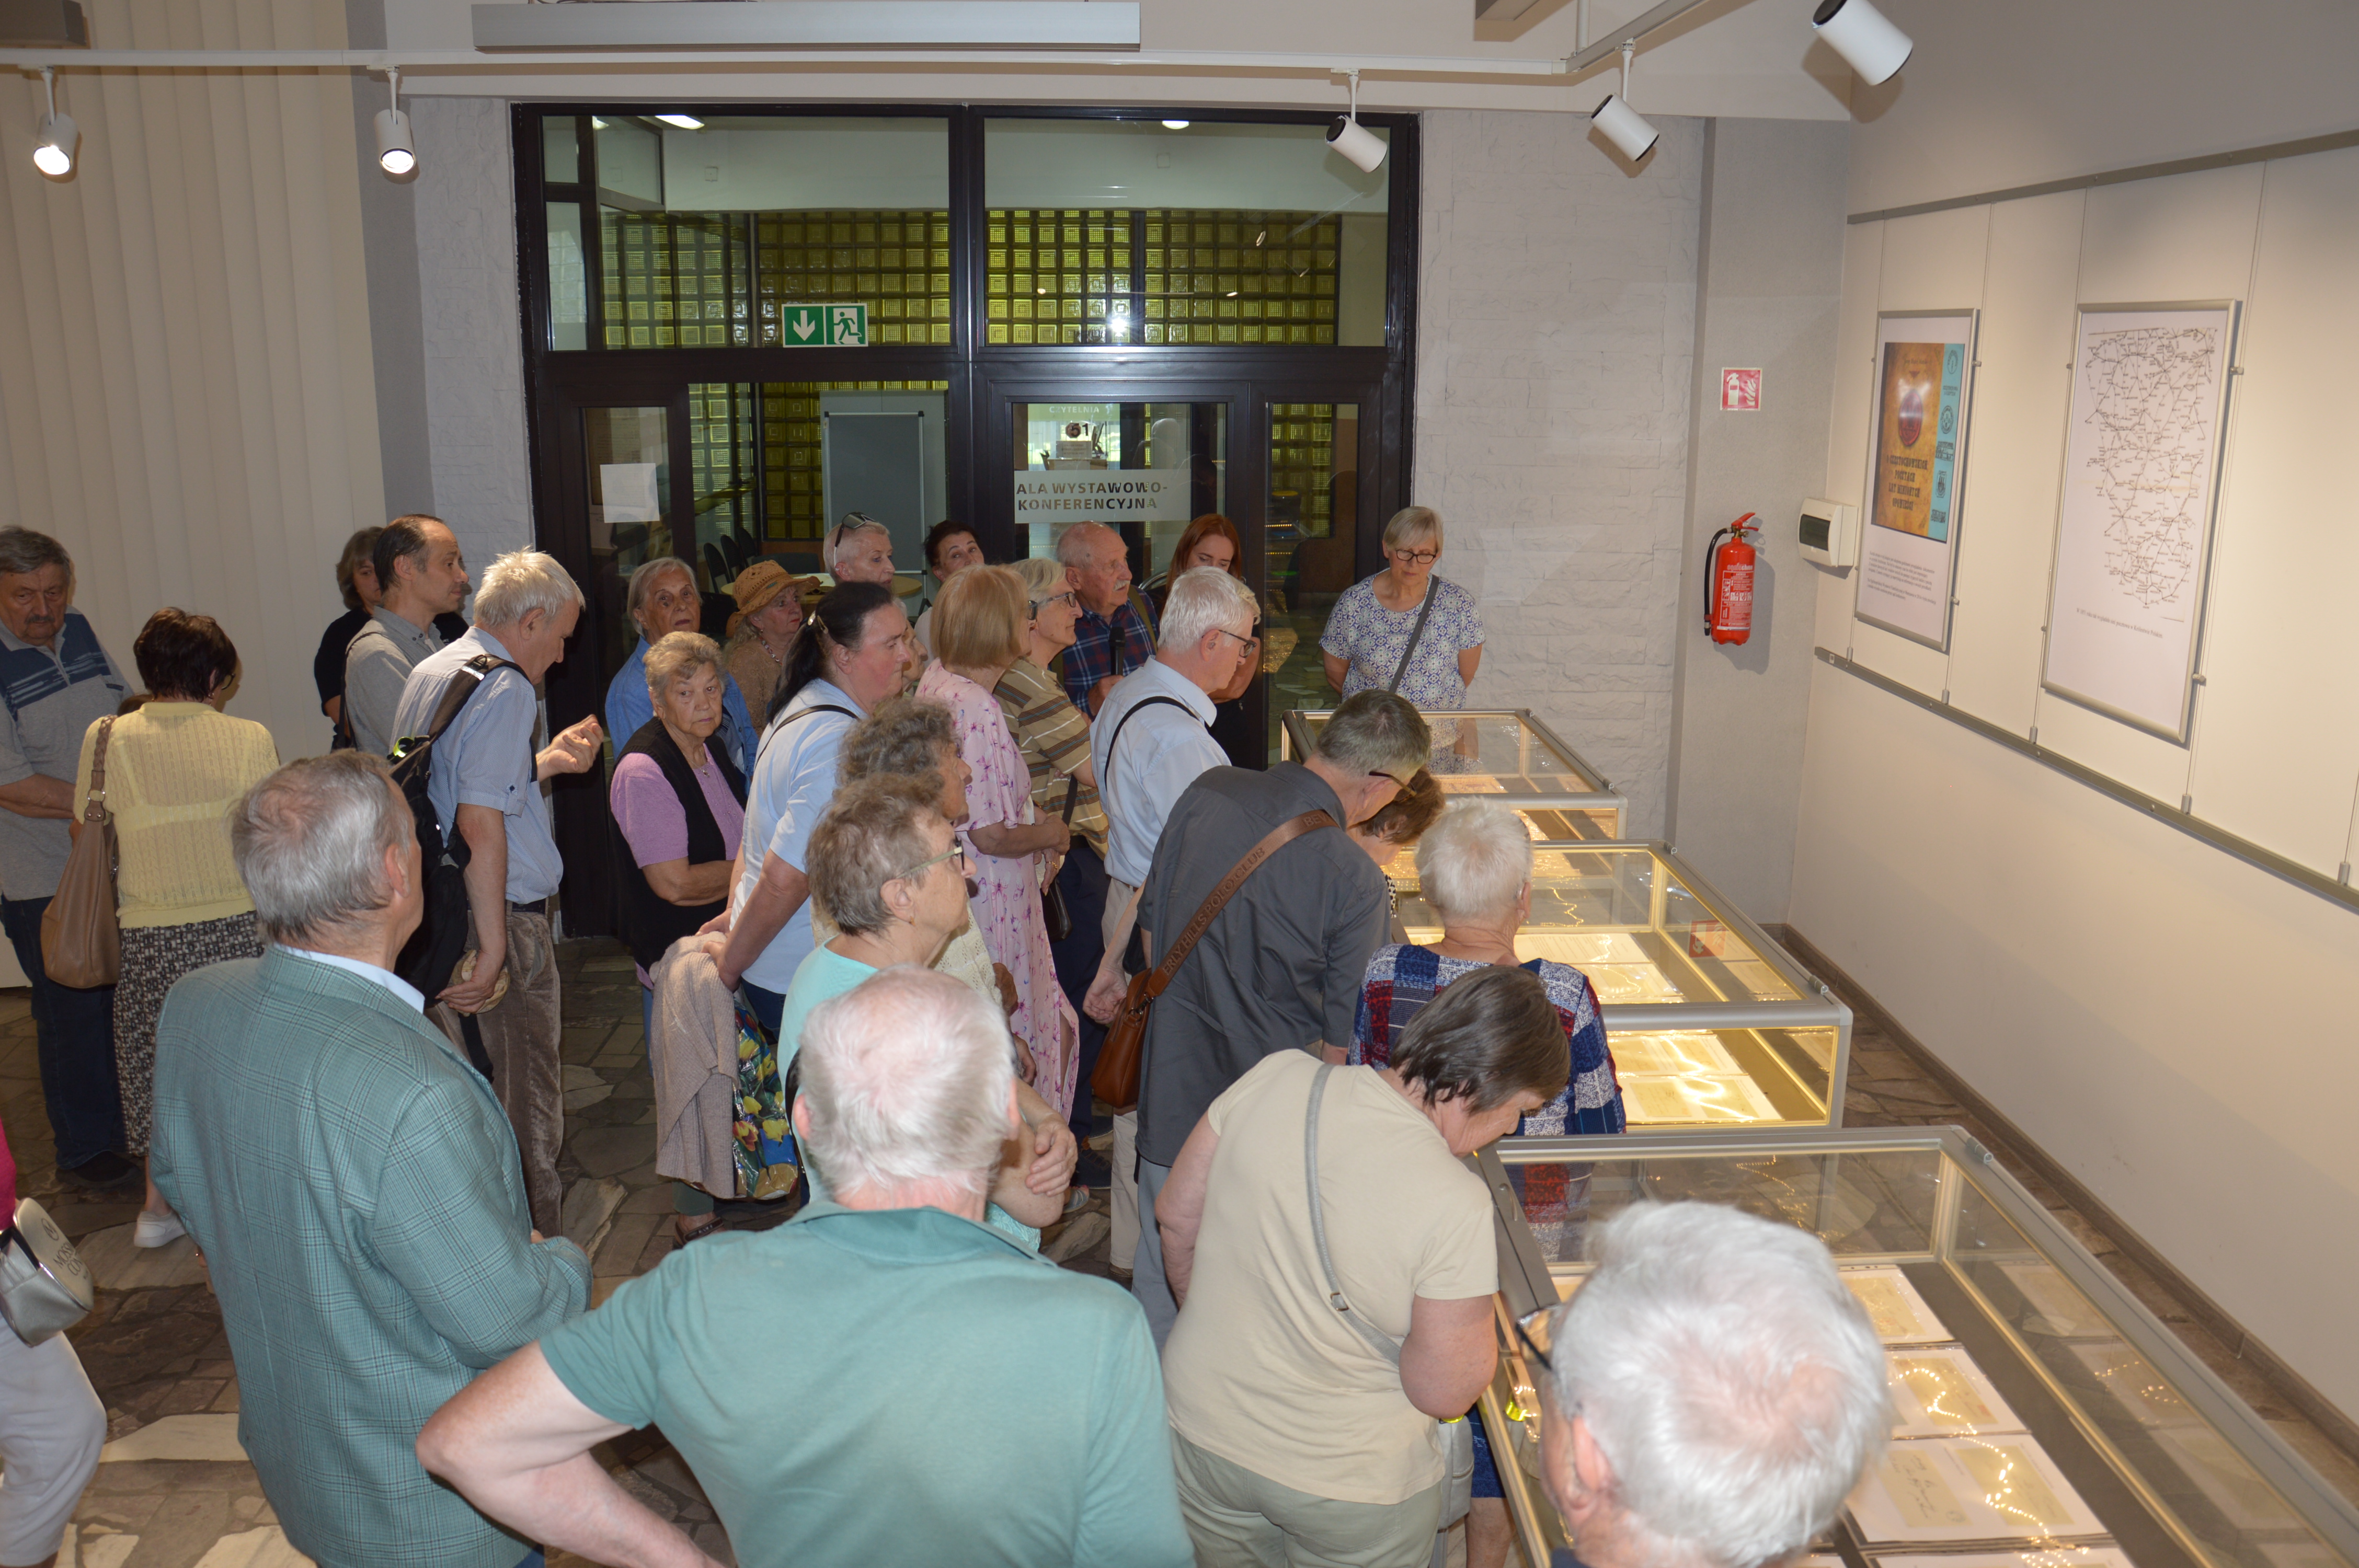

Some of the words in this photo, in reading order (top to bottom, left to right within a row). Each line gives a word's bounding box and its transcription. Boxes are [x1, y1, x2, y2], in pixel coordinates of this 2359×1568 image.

[1016, 483, 1048, 495] ALA
[1052, 482, 1168, 494] WYSTAWOWO-
[1018, 498, 1157, 511] KONFERENCYJNA
[1182, 914, 1207, 949] HILLS
[1205, 879, 1234, 914] POLO
[1234, 847, 1266, 880] CLUB
